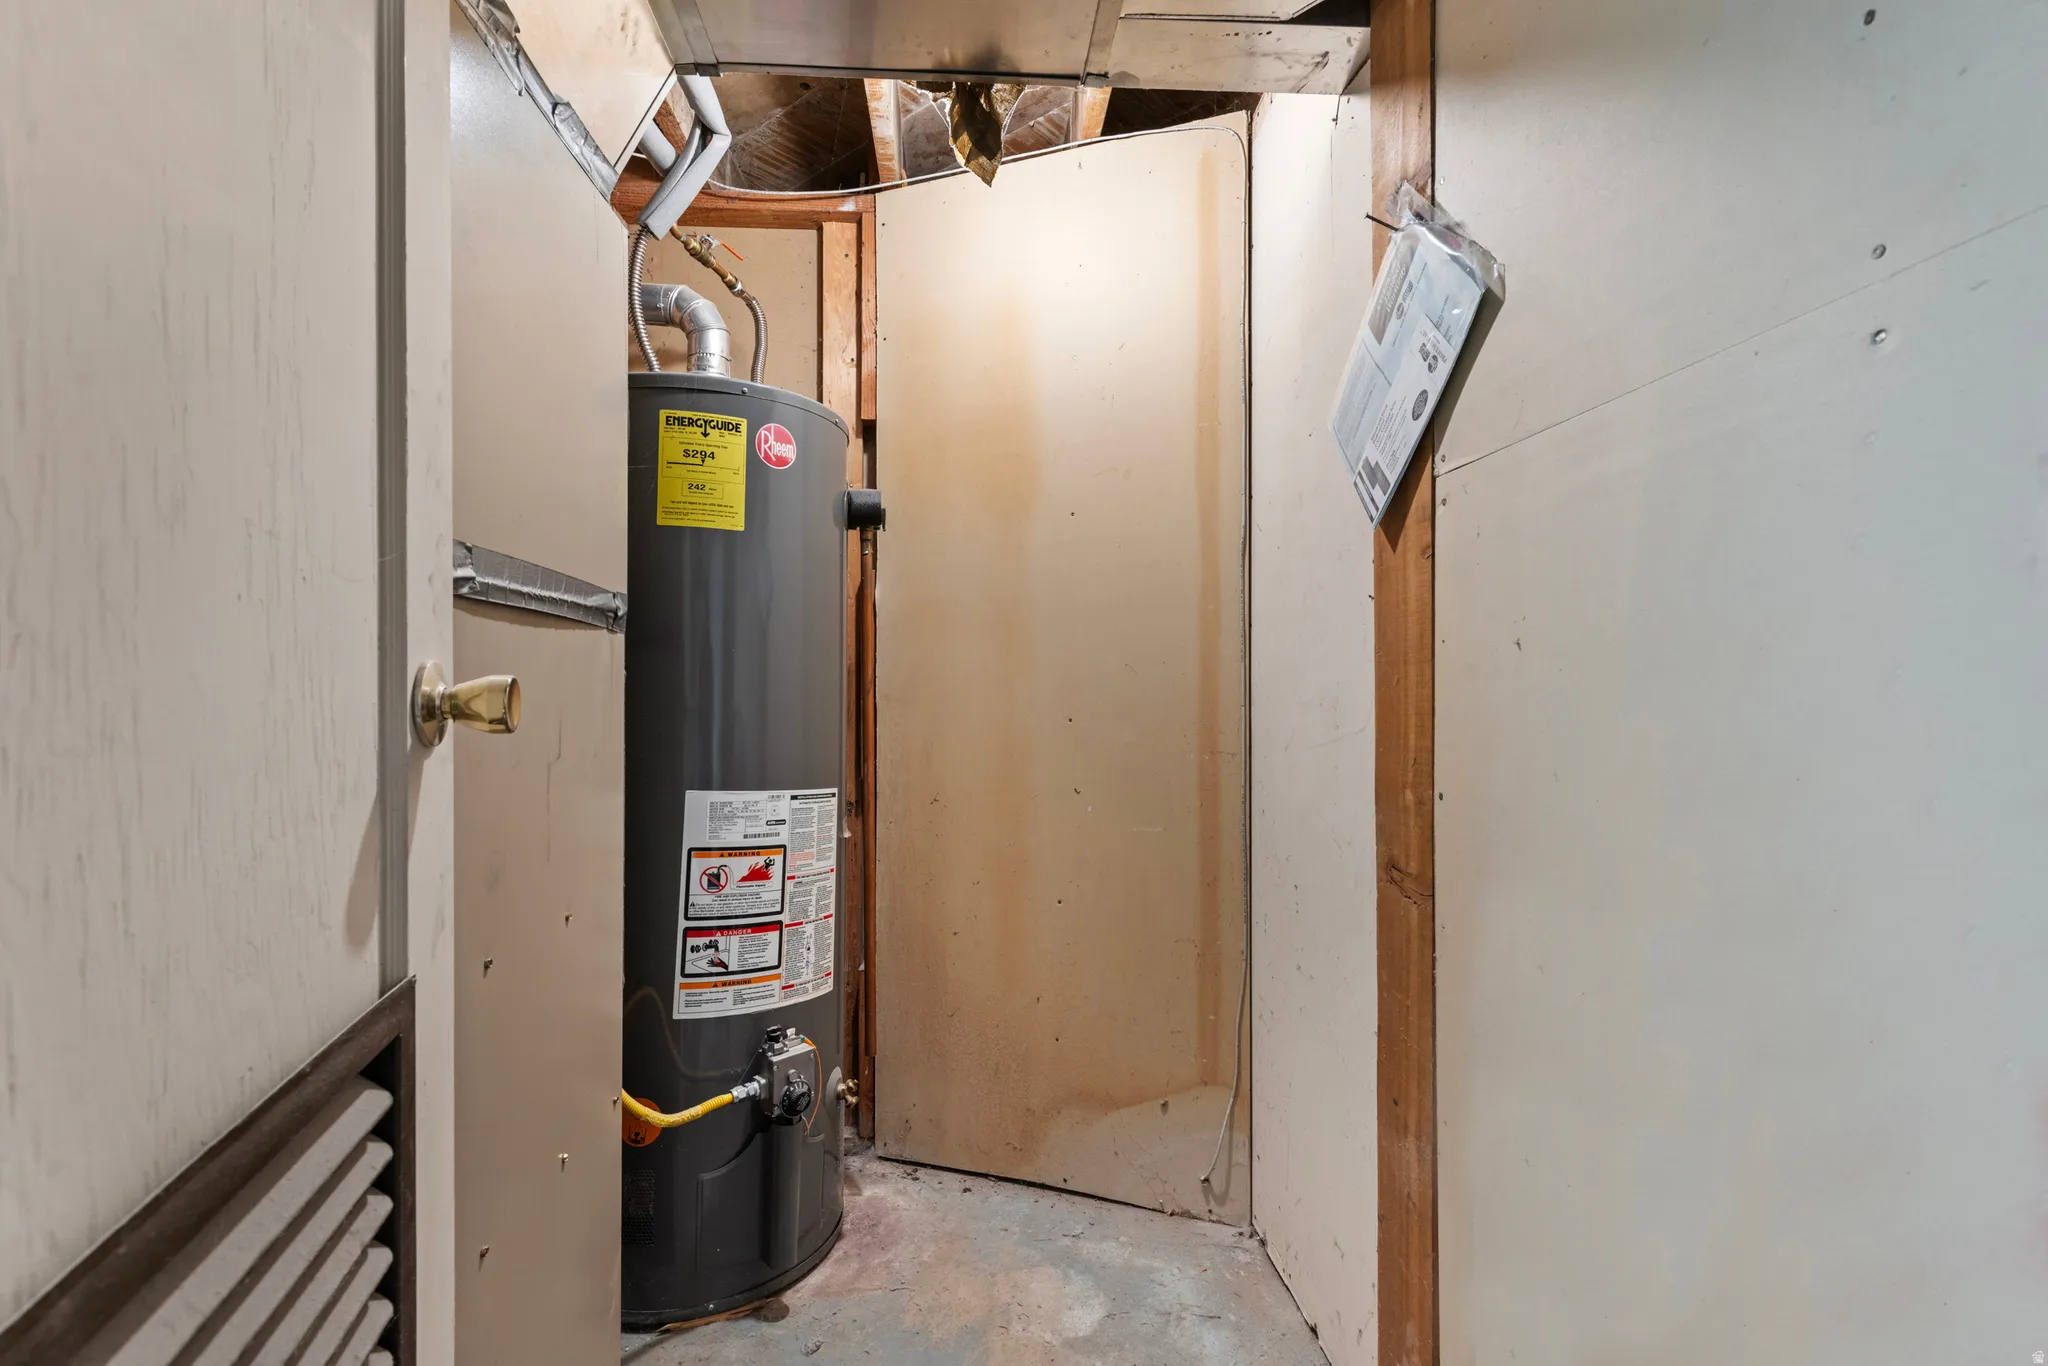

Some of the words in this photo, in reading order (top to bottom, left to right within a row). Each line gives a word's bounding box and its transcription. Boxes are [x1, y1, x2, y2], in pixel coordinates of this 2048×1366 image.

[665, 415, 742, 434] ENERGYGUIDE
[761, 424, 794, 462] Rheem
[682, 448, 716, 461] $294
[688, 483, 706, 491] 242
[722, 979, 752, 987] WARNING
